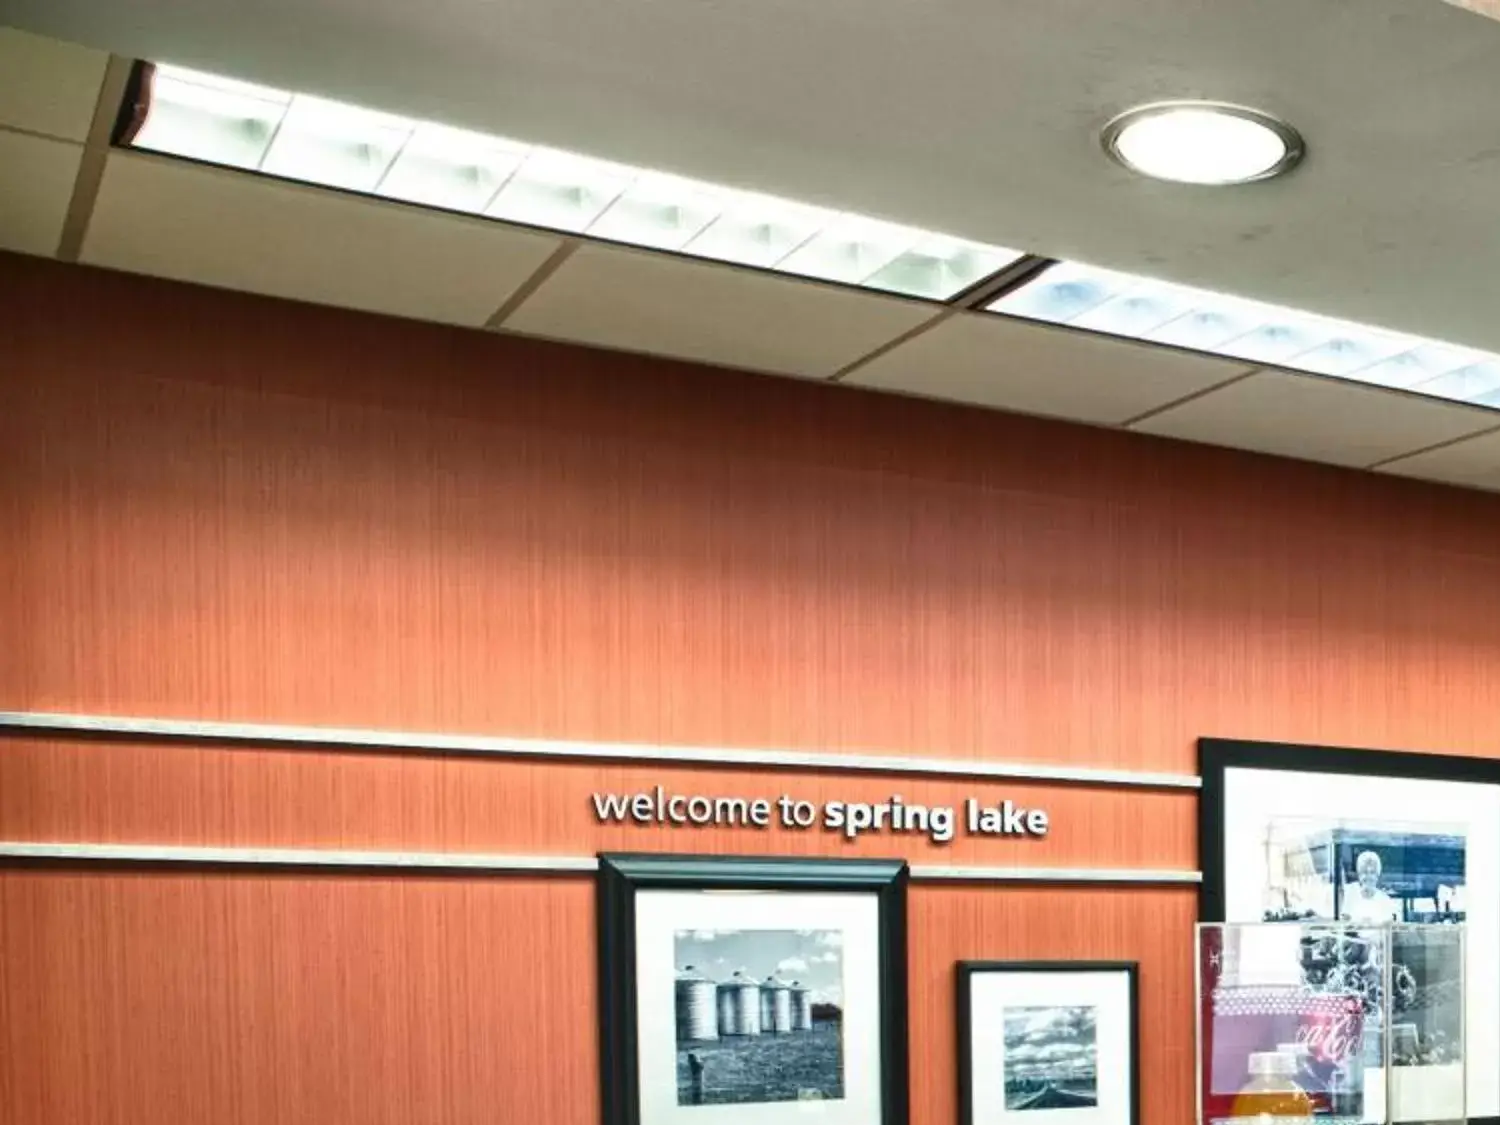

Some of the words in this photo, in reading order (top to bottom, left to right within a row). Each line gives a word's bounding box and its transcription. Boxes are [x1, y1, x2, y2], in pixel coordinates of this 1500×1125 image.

[593, 786, 769, 826] welcome
[779, 794, 815, 827] to
[824, 794, 955, 841] spring
[966, 798, 1049, 835] lake
